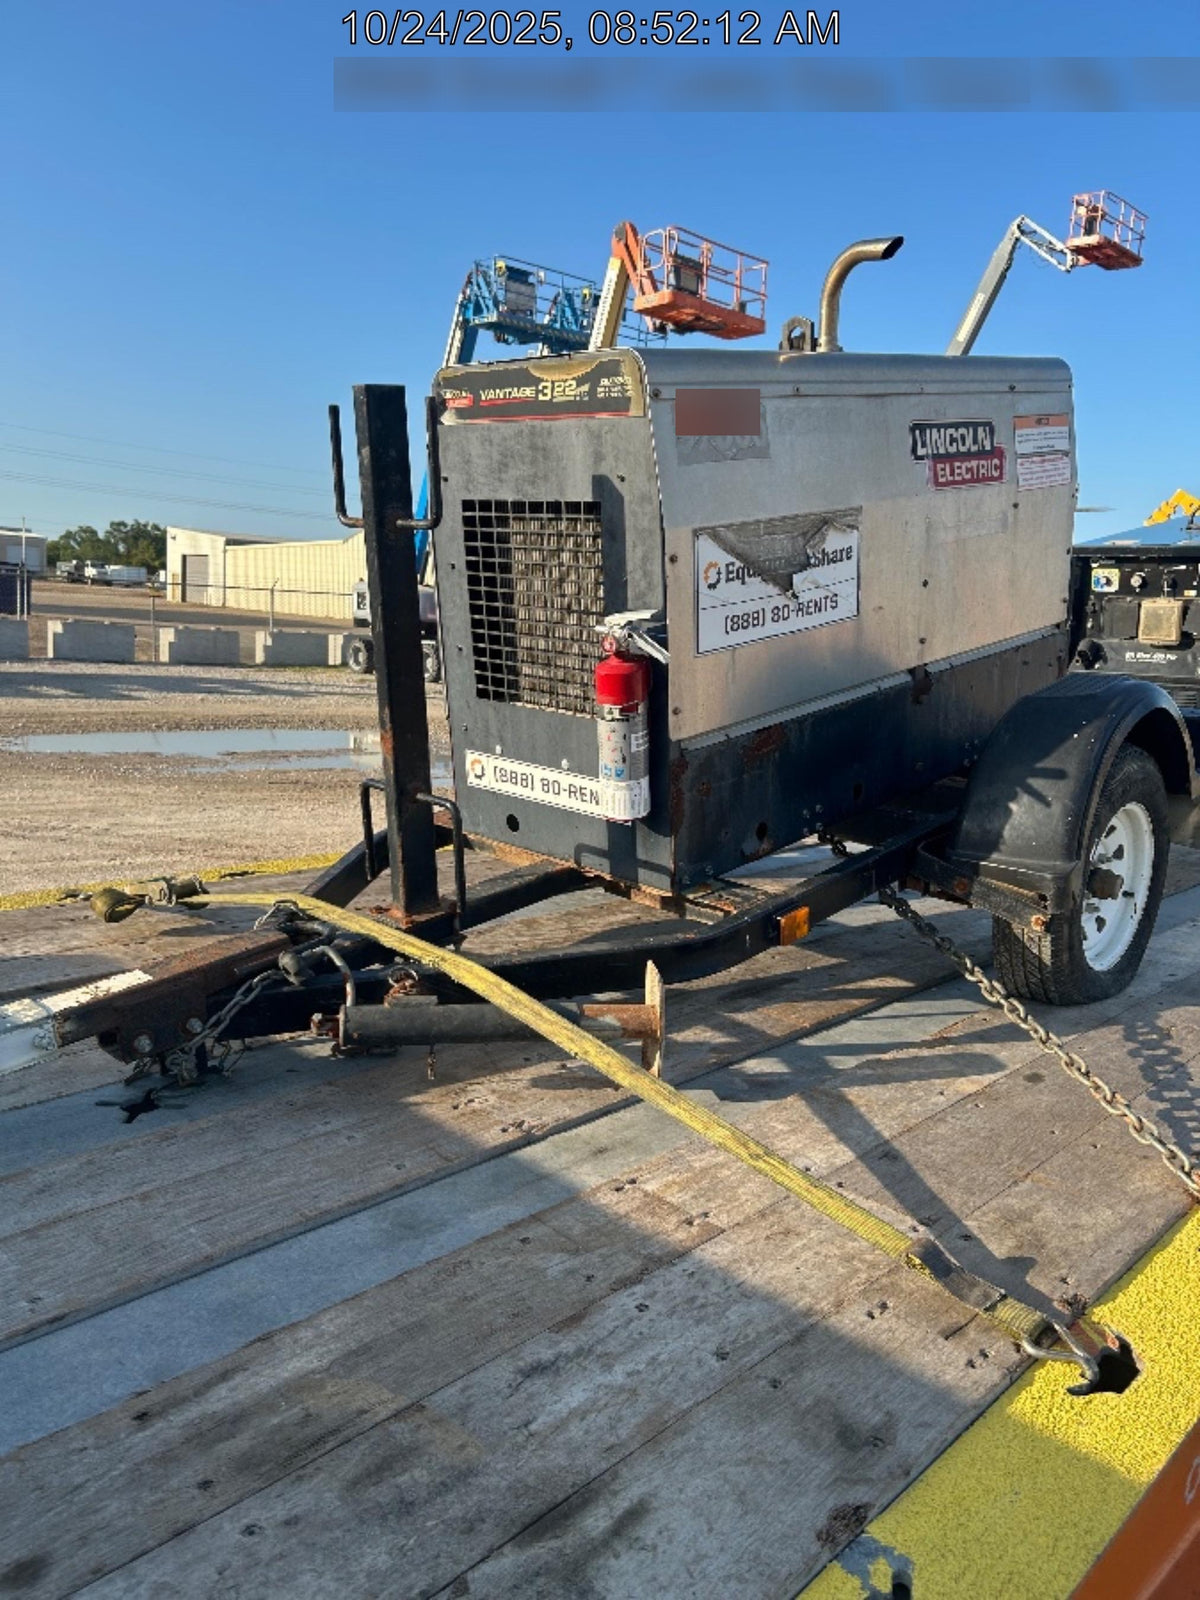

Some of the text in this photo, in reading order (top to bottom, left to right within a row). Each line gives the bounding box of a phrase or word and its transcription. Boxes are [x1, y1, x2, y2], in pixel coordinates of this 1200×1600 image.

[479, 386, 536, 401] VANTAGE
[914, 426, 991, 456] LINCOLN
[936, 458, 1000, 483] ELECTRIC
[724, 593, 839, 635] (888) 80-RENTS
[493, 766, 535, 792] (888)
[540, 777, 600, 806] 80-REN
